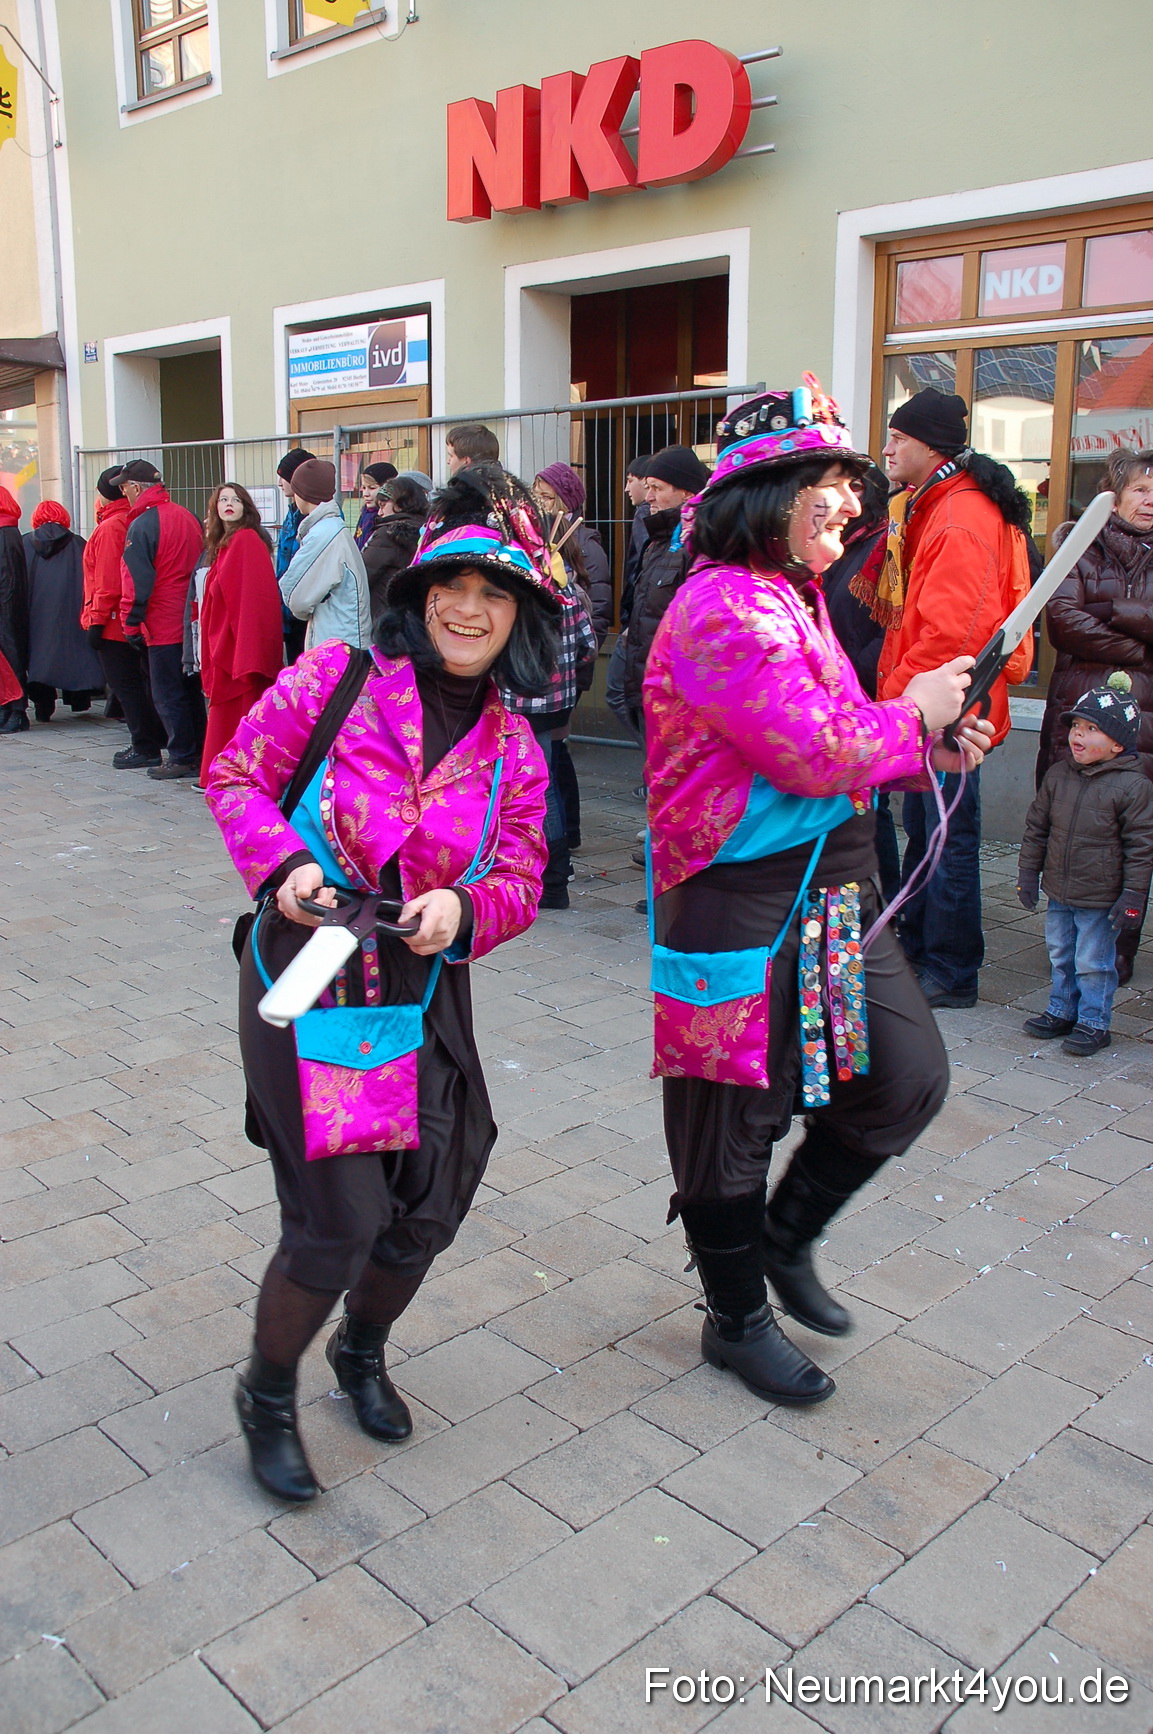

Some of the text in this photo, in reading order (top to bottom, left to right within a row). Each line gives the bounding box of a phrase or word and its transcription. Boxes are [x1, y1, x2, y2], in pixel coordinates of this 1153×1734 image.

[447, 40, 751, 223] NKD
[985, 264, 1064, 301] NKD
[290, 354, 365, 374] IMMOBILIENBÜRO
[372, 341, 402, 368] ivd
